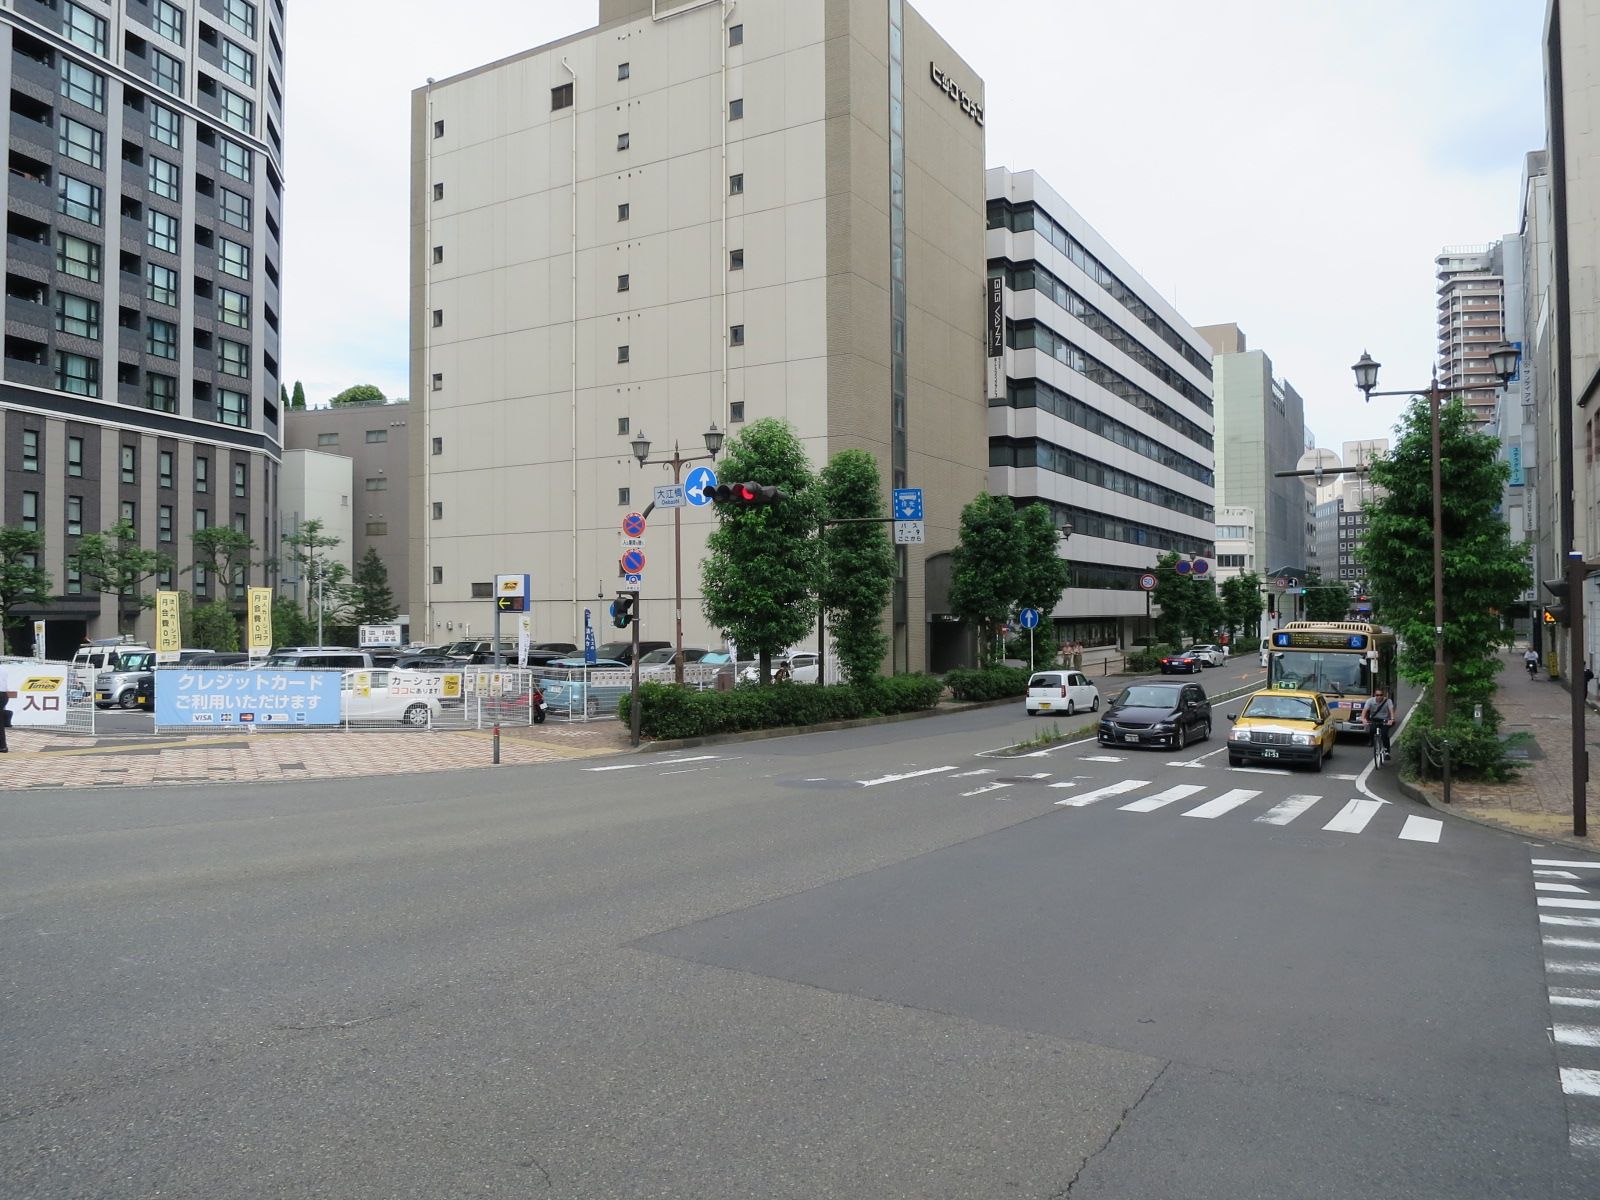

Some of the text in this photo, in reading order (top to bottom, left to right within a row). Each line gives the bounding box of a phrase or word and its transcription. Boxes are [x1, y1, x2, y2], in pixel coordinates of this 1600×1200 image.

[657, 487, 683, 499] 大江橋
[27, 681, 57, 690] Times
[178, 673, 323, 691] クレジットカード
[392, 677, 440, 686] カーシェア
[22, 695, 60, 711] 入口
[176, 694, 321, 710] ご利用いただけます
